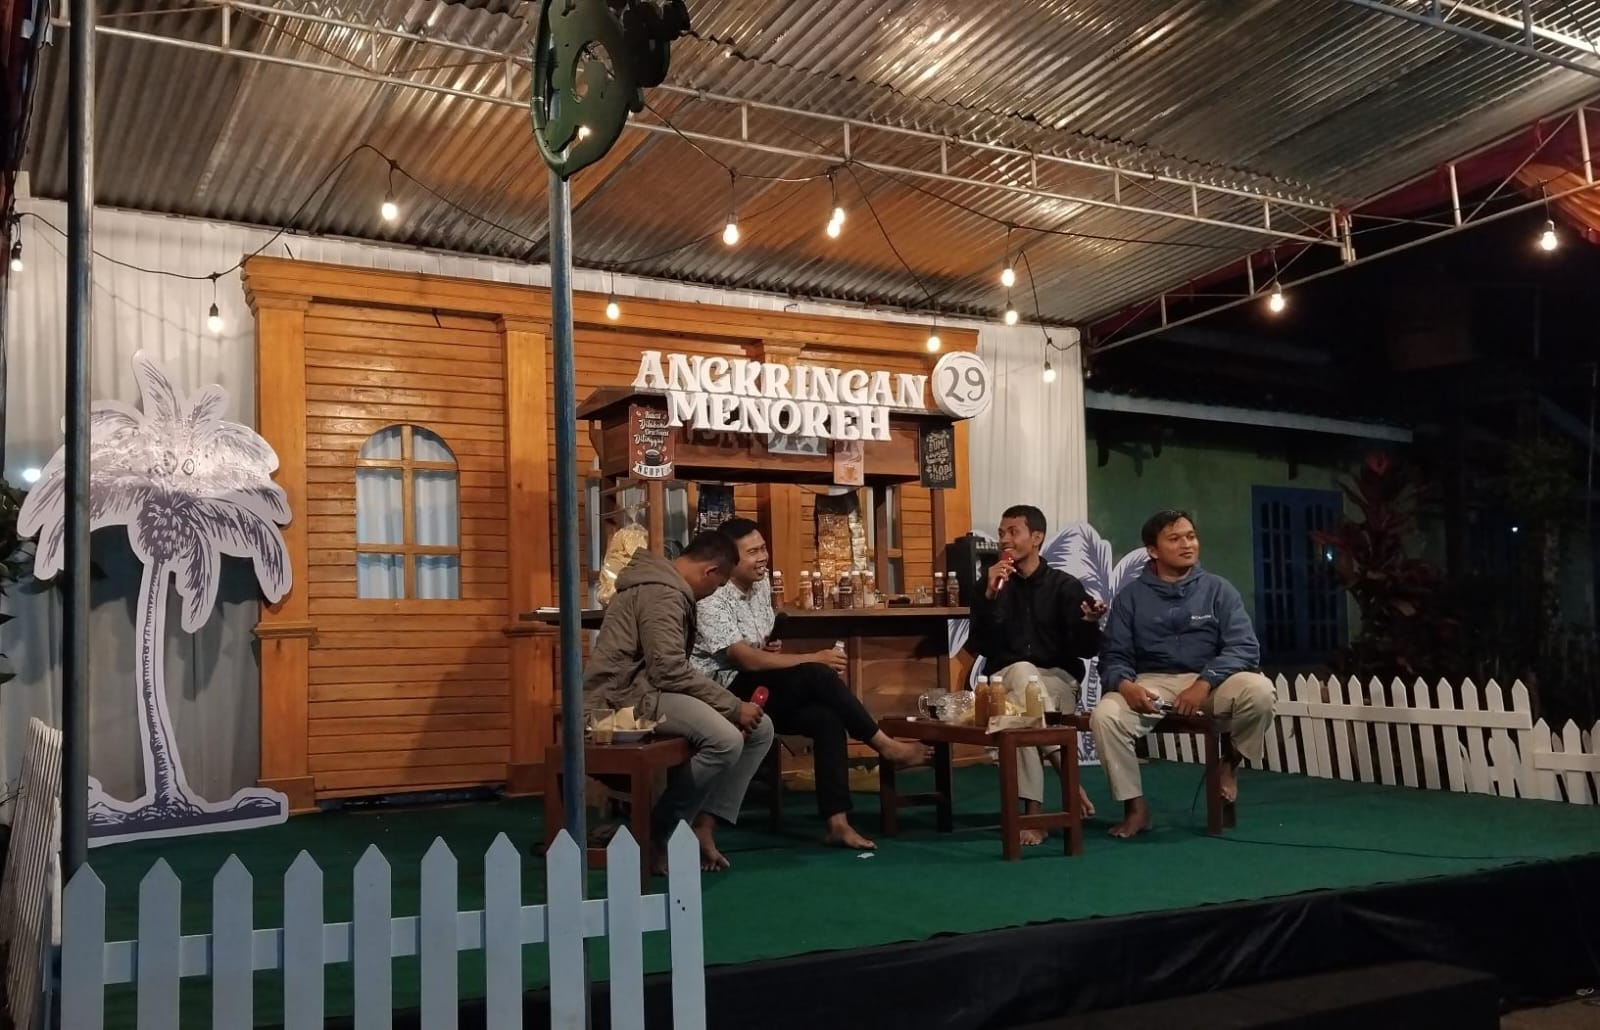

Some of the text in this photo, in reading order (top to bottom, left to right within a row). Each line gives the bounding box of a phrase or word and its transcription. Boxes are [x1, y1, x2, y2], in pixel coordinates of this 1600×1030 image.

[632, 350, 928, 408] ANGKRINGAN
[943, 365, 987, 402] 29
[665, 390, 892, 441] MENOREH
